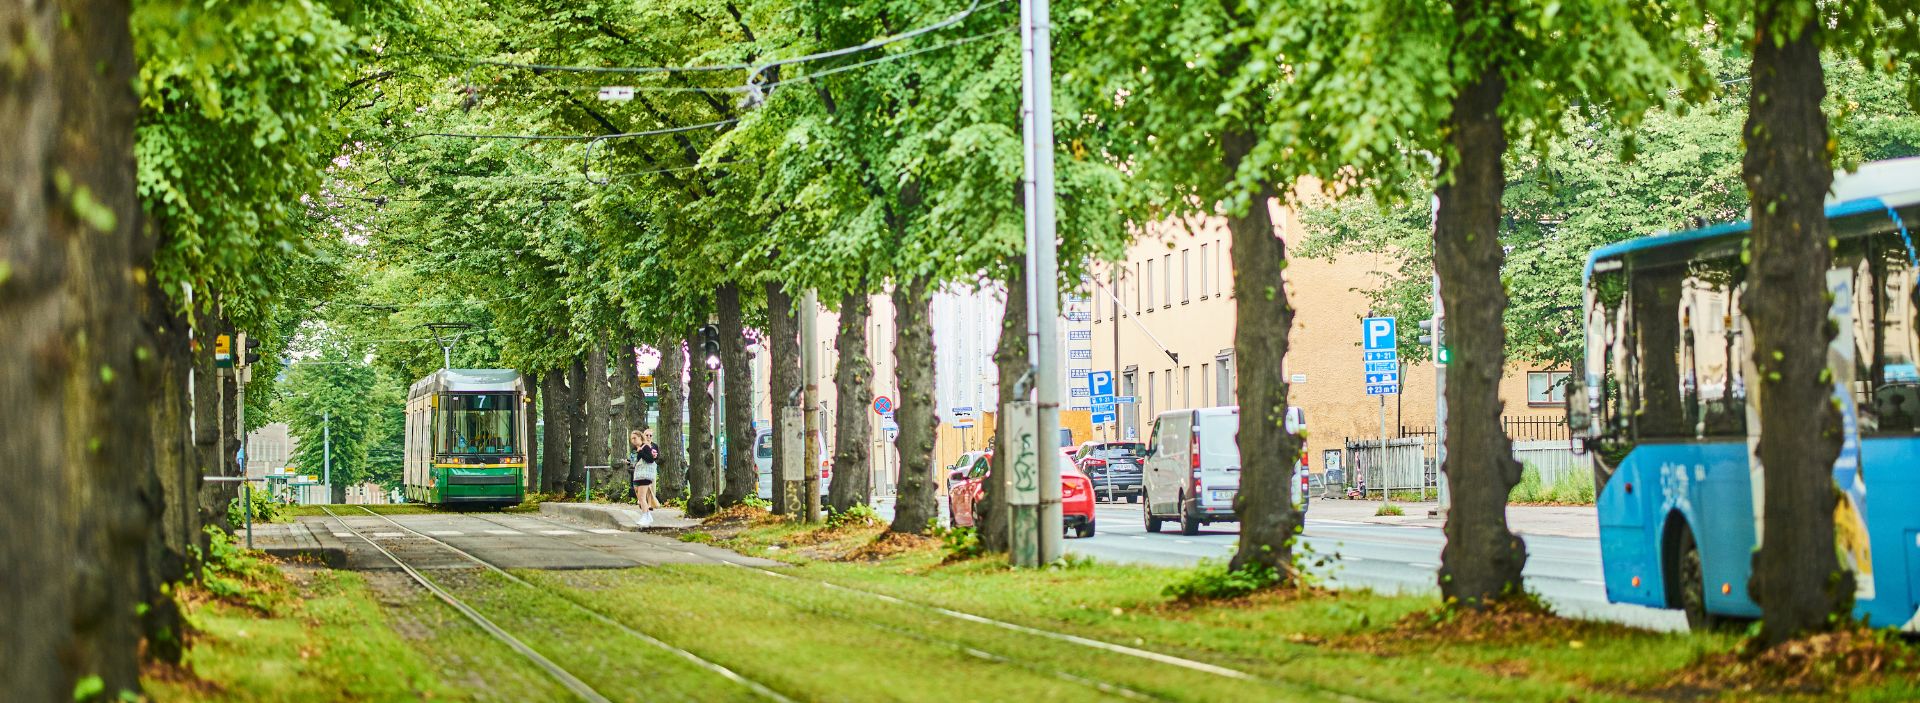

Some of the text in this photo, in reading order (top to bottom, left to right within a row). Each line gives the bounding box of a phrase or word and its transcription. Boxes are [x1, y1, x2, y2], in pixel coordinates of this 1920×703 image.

[1369, 320, 1390, 348] P
[1092, 372, 1109, 395] P
[477, 395, 486, 409] 7
